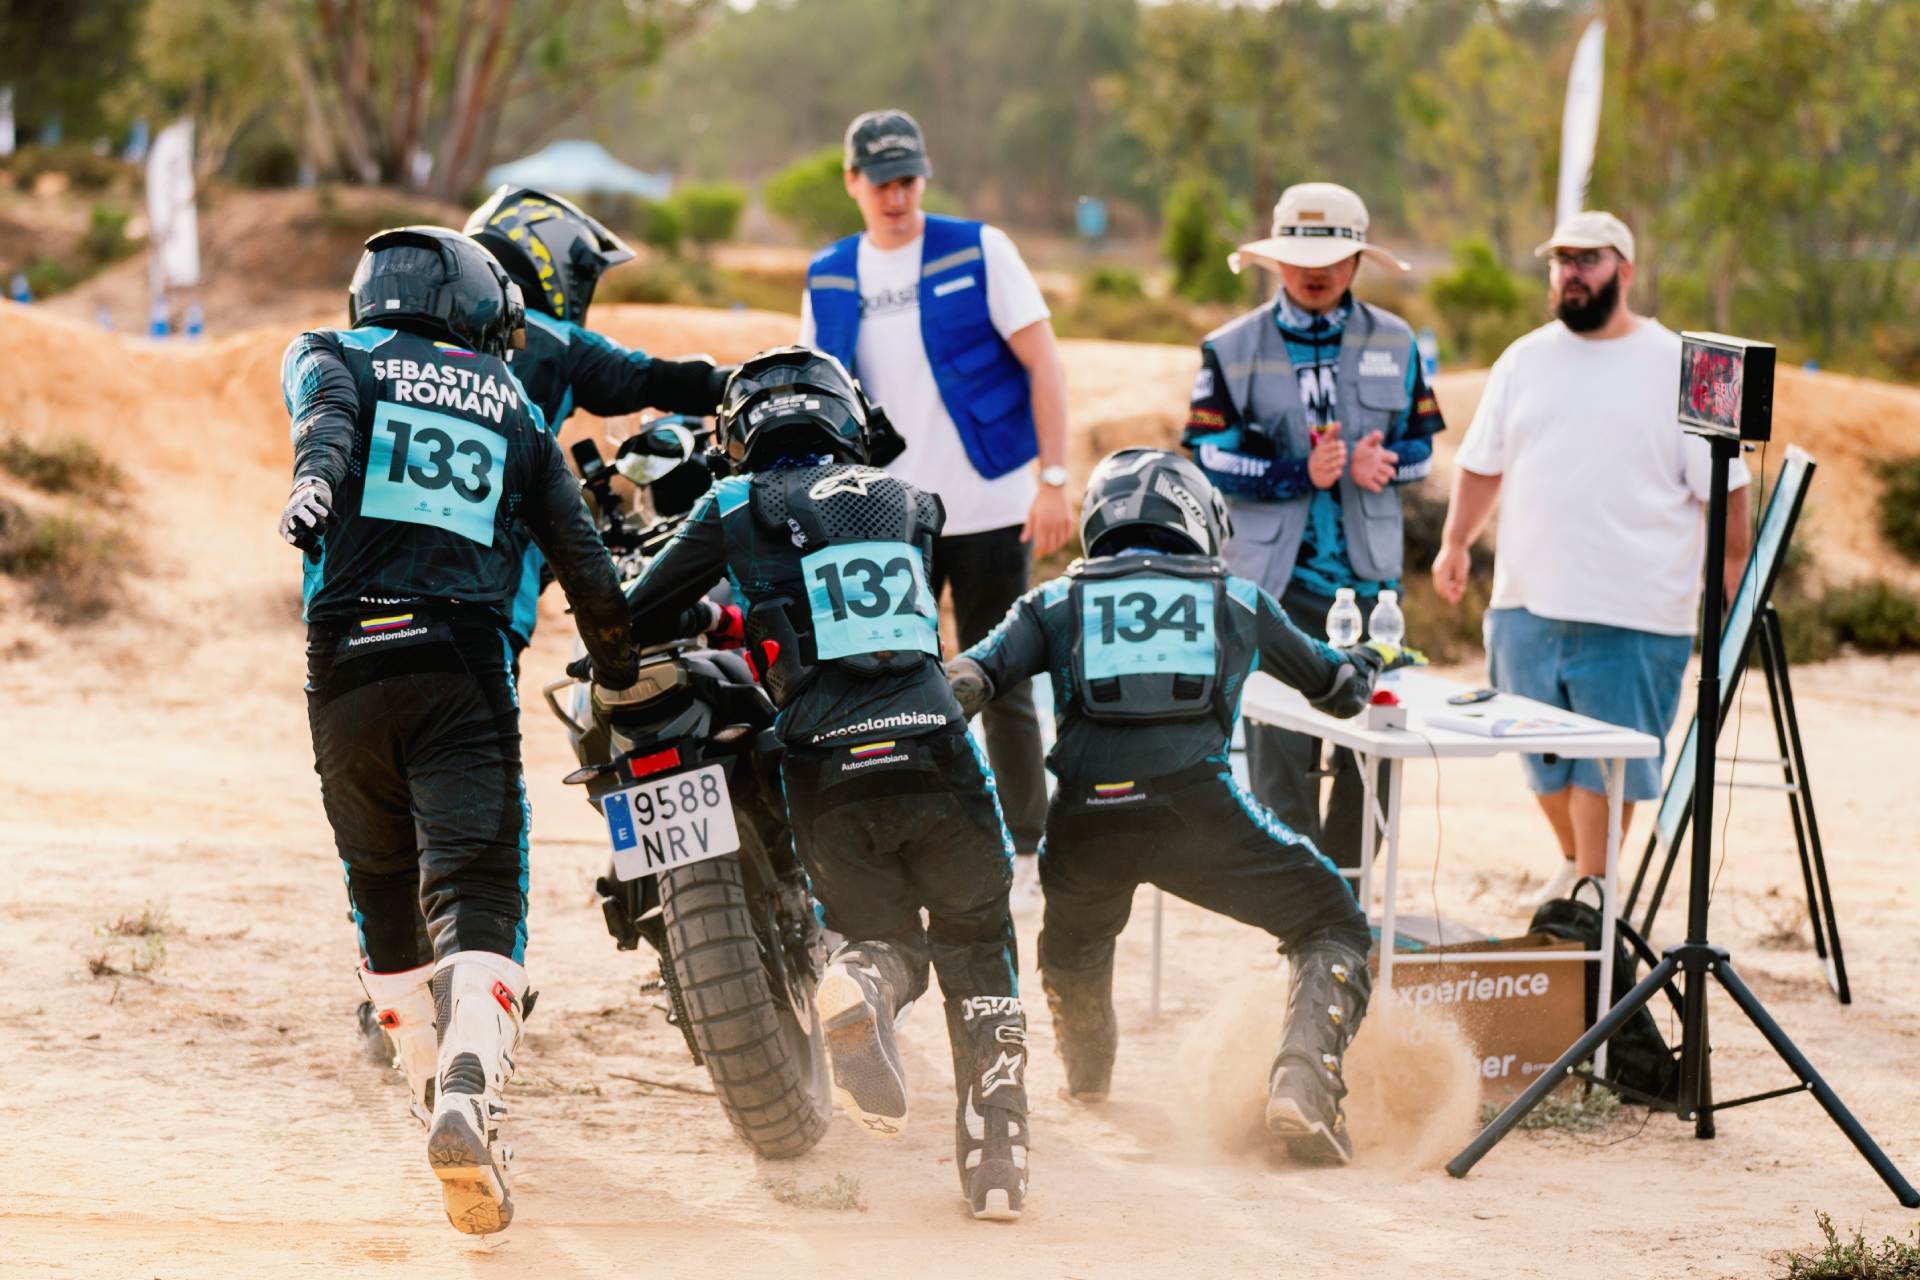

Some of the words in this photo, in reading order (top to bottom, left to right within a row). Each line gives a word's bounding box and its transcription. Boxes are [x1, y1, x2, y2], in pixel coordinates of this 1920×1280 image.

[372, 359, 518, 410] SEBASTIÁN
[387, 419, 493, 504] 133
[815, 557, 928, 622] 132
[348, 627, 428, 647] Autocolombiana
[1093, 592, 1205, 645] 134
[841, 753, 909, 771] Autocolombiana
[634, 774, 720, 826] 9588
[618, 827, 629, 841] E
[642, 817, 708, 868] NRV
[1392, 970, 1549, 1014] xperience
